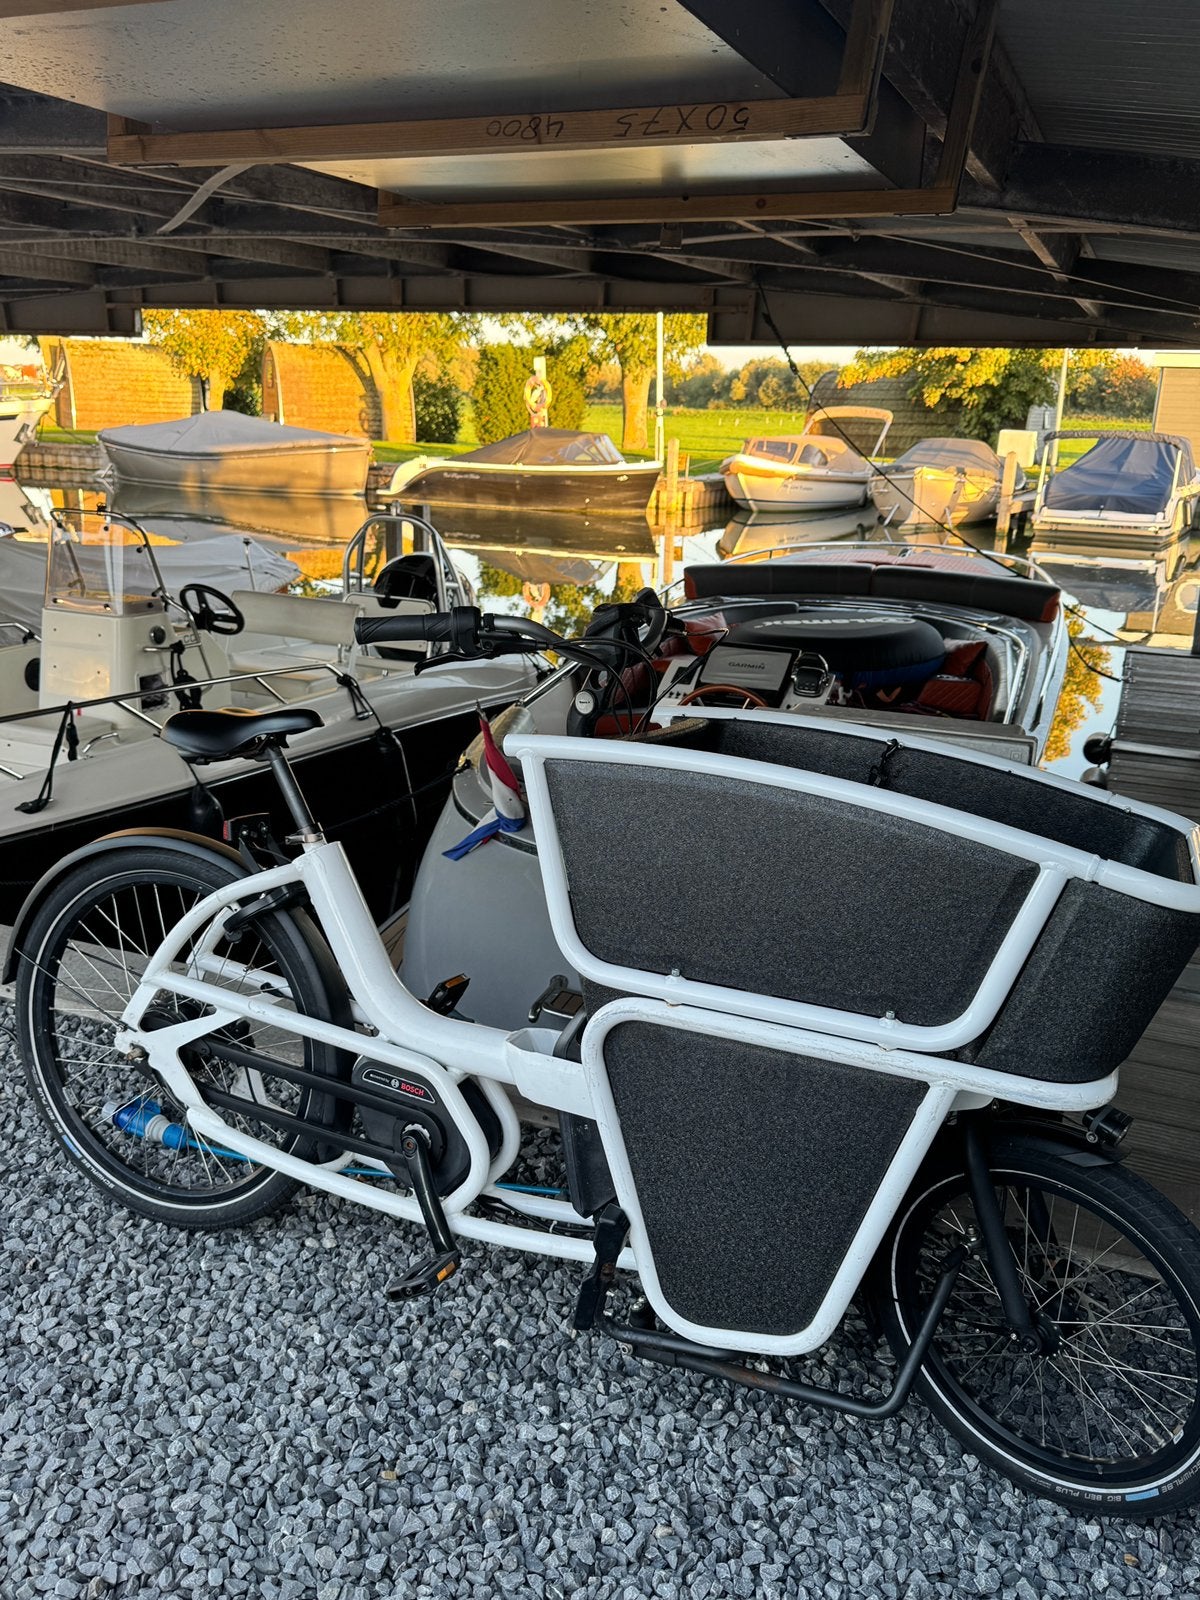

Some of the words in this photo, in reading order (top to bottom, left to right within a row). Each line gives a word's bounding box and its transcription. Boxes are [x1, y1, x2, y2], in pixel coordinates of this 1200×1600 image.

[486, 115, 564, 139] 4800
[728, 661, 765, 670] GARMIN
[401, 1083, 424, 1096] BOSCH
[1055, 1485, 1080, 1498] PLUS
